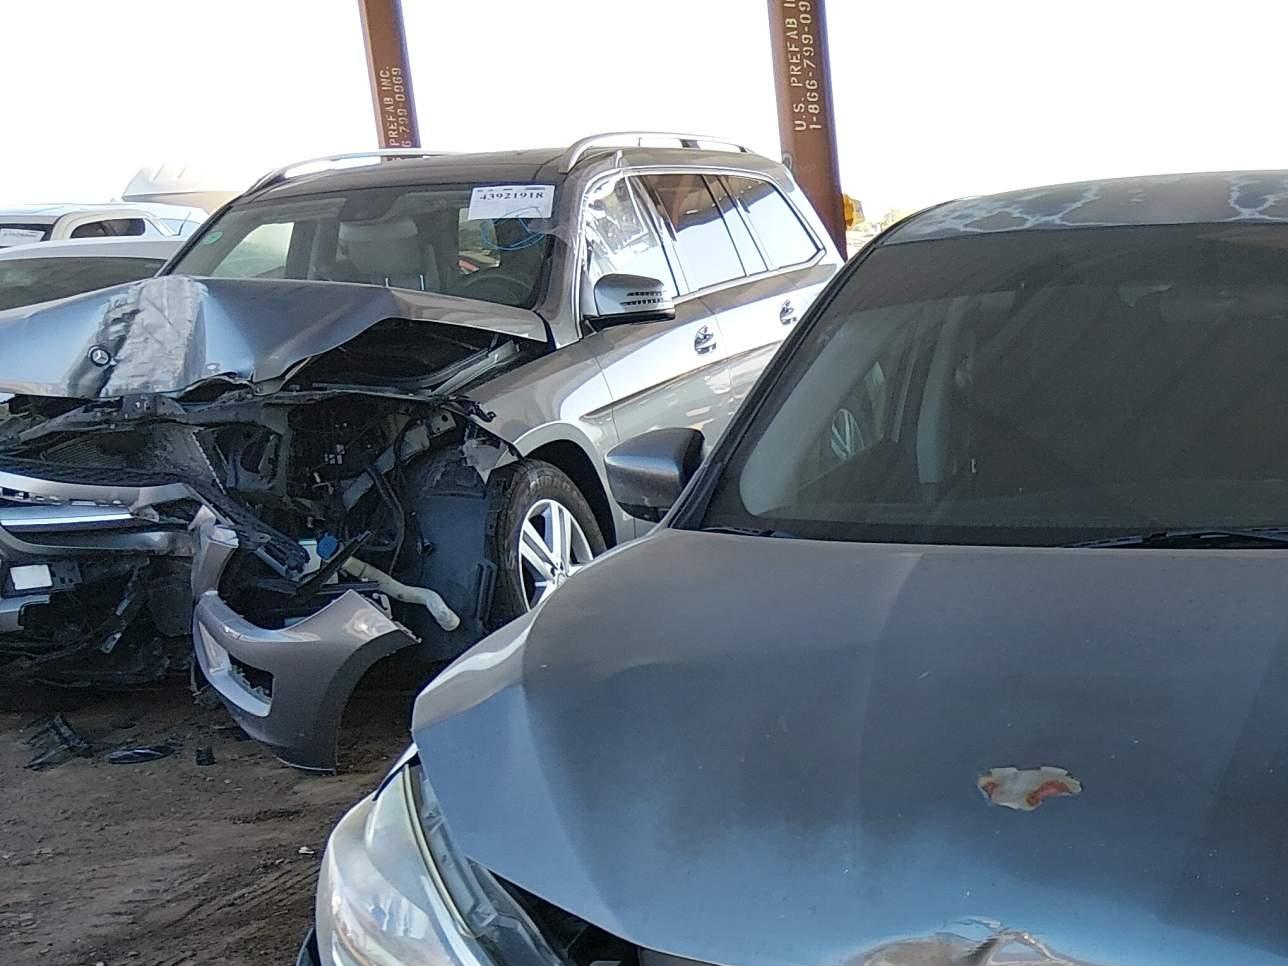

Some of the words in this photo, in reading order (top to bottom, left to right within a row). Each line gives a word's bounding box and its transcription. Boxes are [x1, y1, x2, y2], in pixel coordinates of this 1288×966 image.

[785, 18, 803, 87] PREFAB
[379, 66, 393, 90] INC.
[383, 97, 400, 147] PREFAB
[793, 97, 807, 131] U.S.
[480, 191, 544, 200] 43921918
